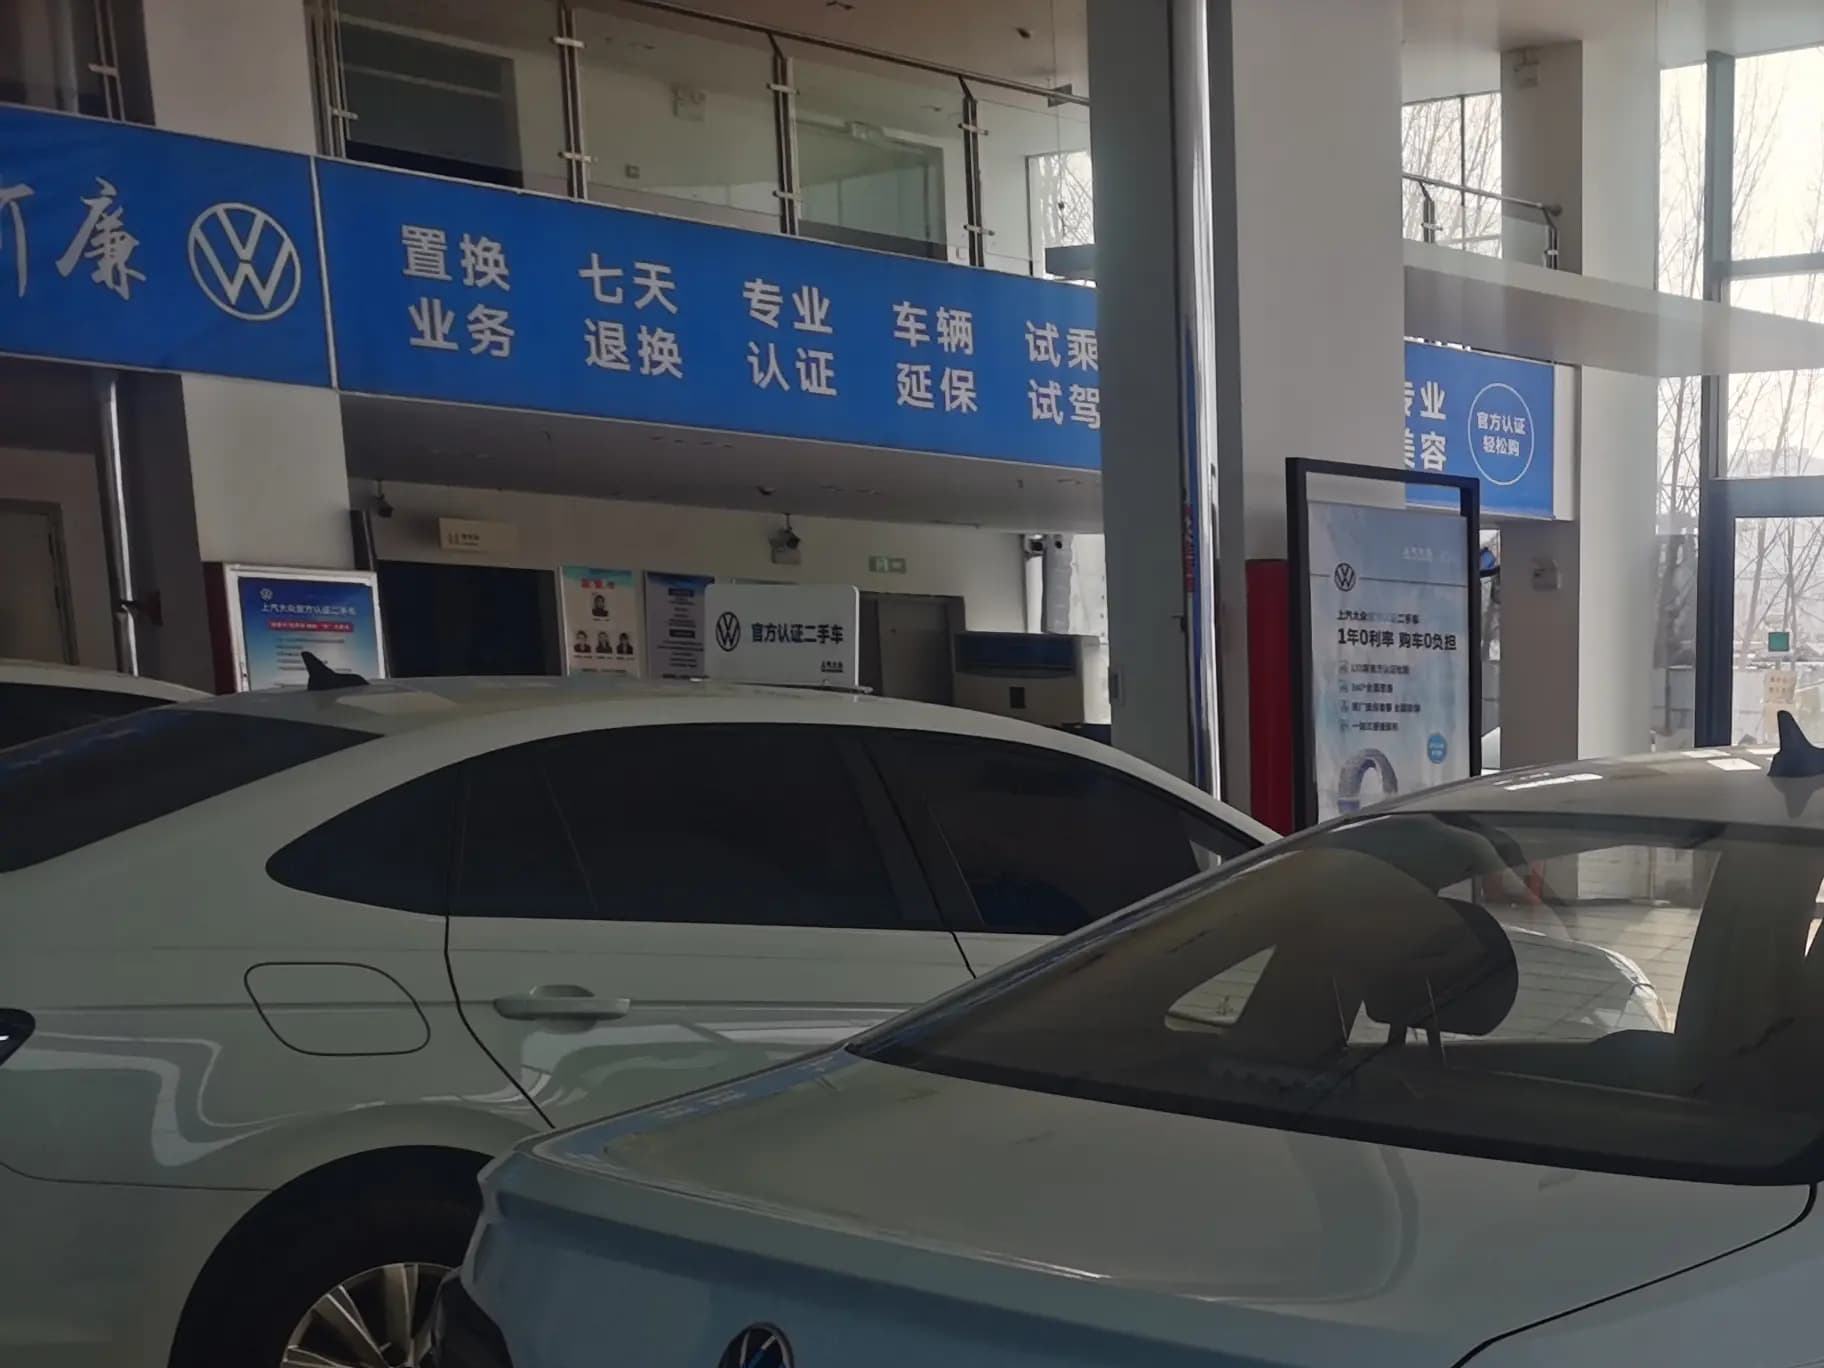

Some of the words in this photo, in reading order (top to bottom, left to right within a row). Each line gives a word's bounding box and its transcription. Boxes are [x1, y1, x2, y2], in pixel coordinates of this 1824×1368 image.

[402, 224, 511, 292] 置换
[578, 253, 678, 315] 七天
[408, 297, 515, 358] 业务
[743, 278, 834, 335] 专业
[893, 301, 974, 355] 车辆
[584, 318, 683, 379] 退换
[746, 341, 837, 396] 认证
[1025, 320, 1099, 371] 试乘
[897, 363, 978, 414] 延保
[1028, 379, 1101, 429] 试驾
[1476, 411, 1527, 436] 官方认证
[1483, 435, 1521, 457] 轻松购
[751, 621, 845, 645] 官方认证二手车
[1338, 628, 1394, 647] 1年0利率
[1398, 632, 1457, 651] 购车0负担
